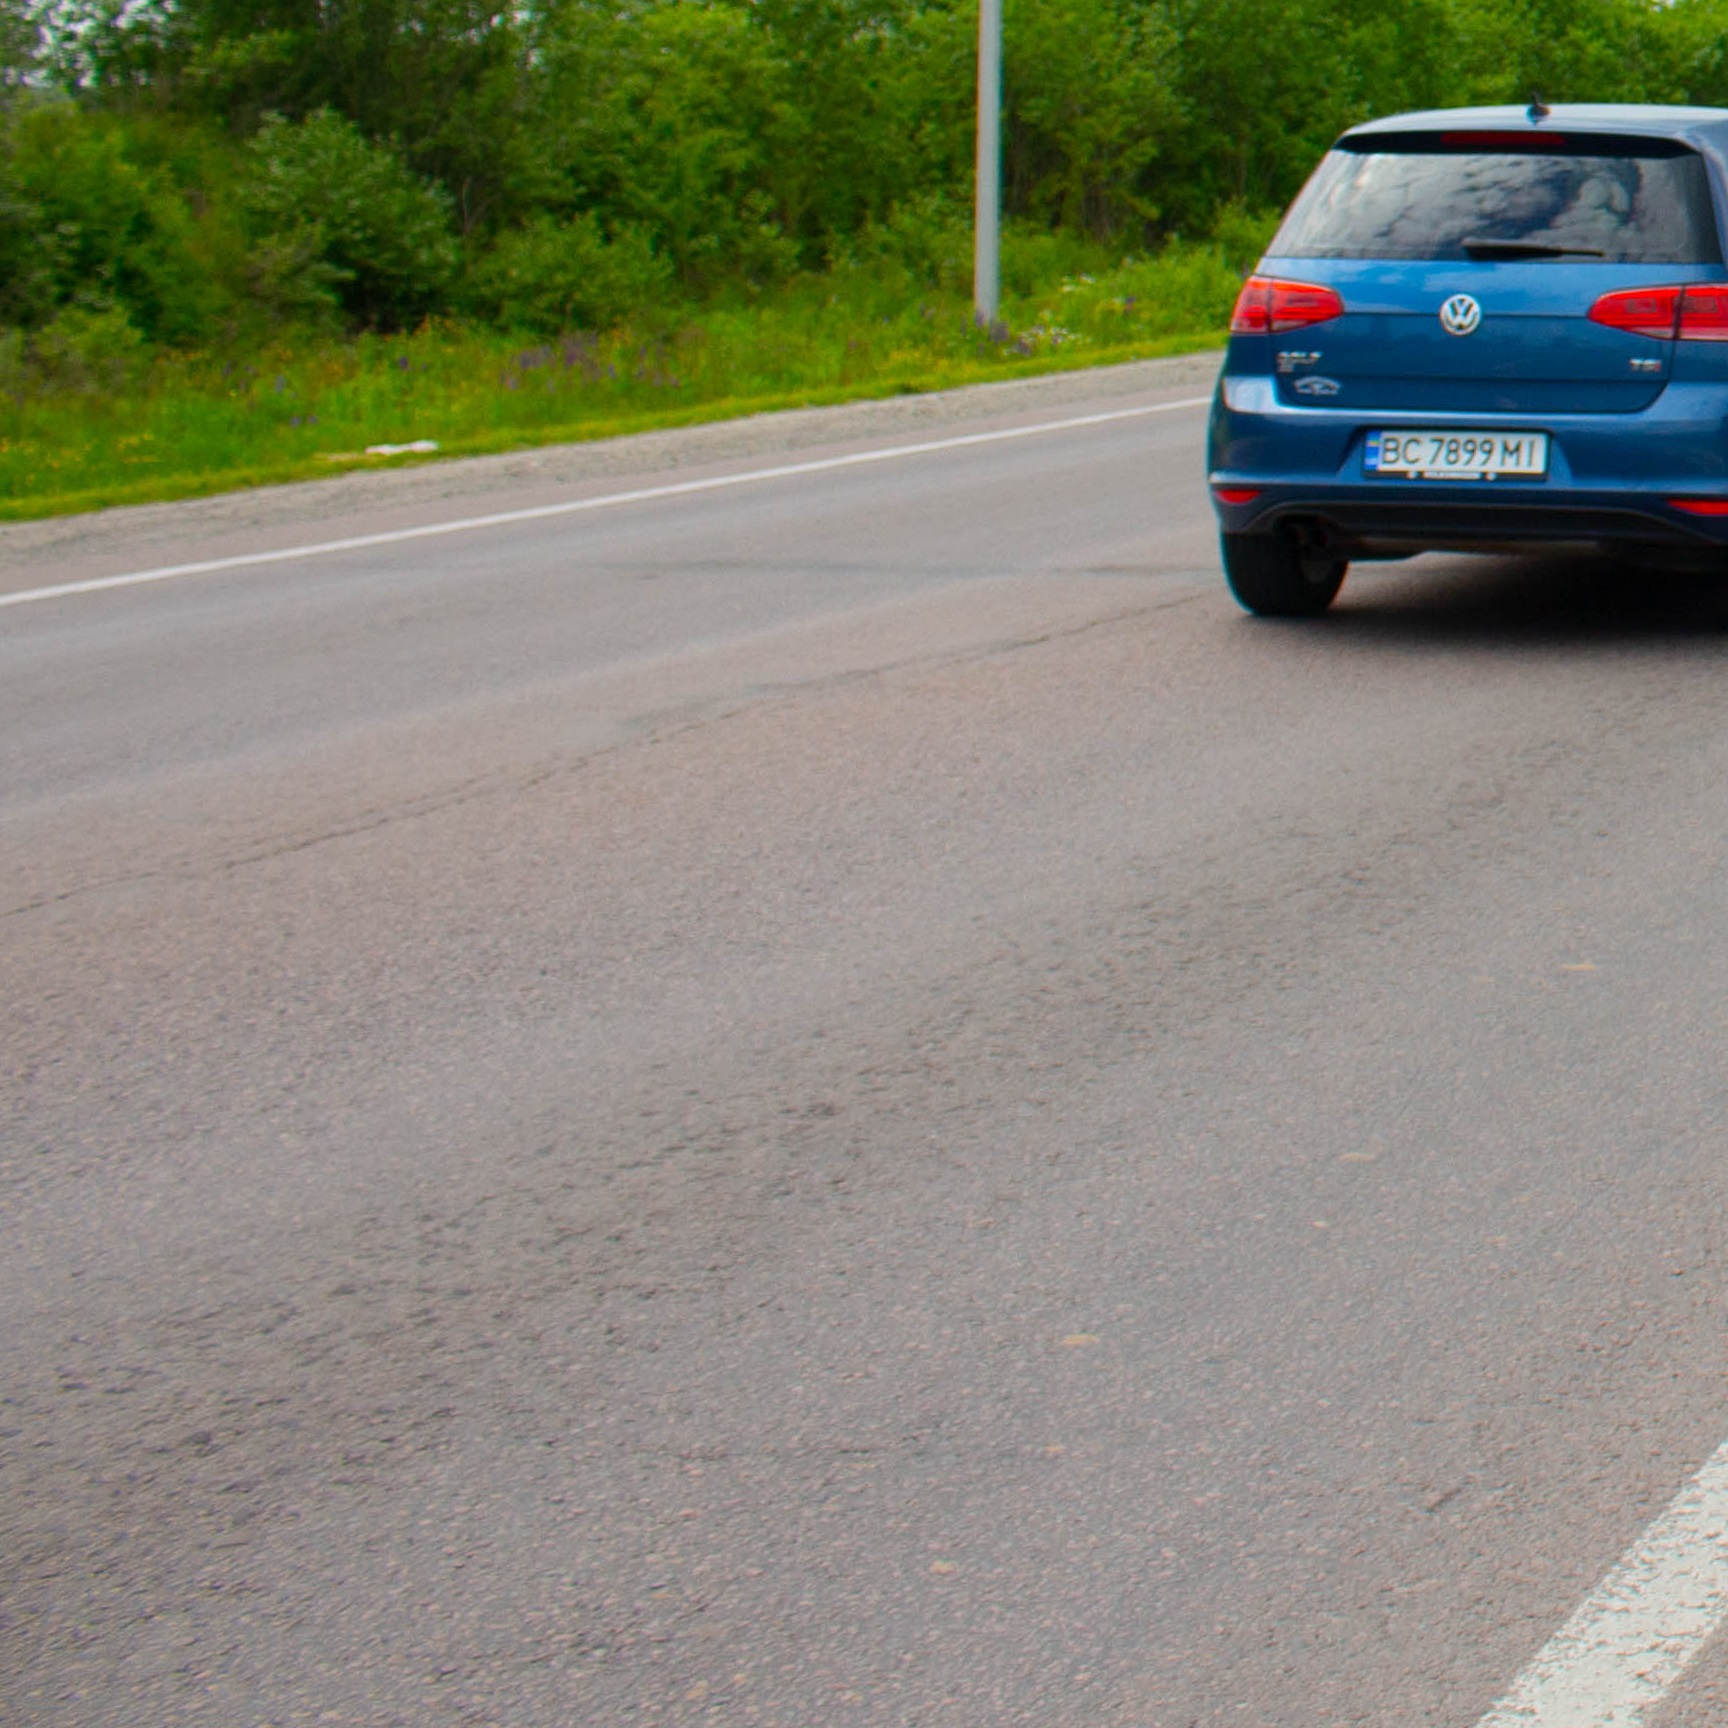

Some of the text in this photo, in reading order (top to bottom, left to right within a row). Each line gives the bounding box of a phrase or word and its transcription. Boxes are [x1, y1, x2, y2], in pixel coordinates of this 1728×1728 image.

[1381, 437, 1537, 468] BC 7899 MI
